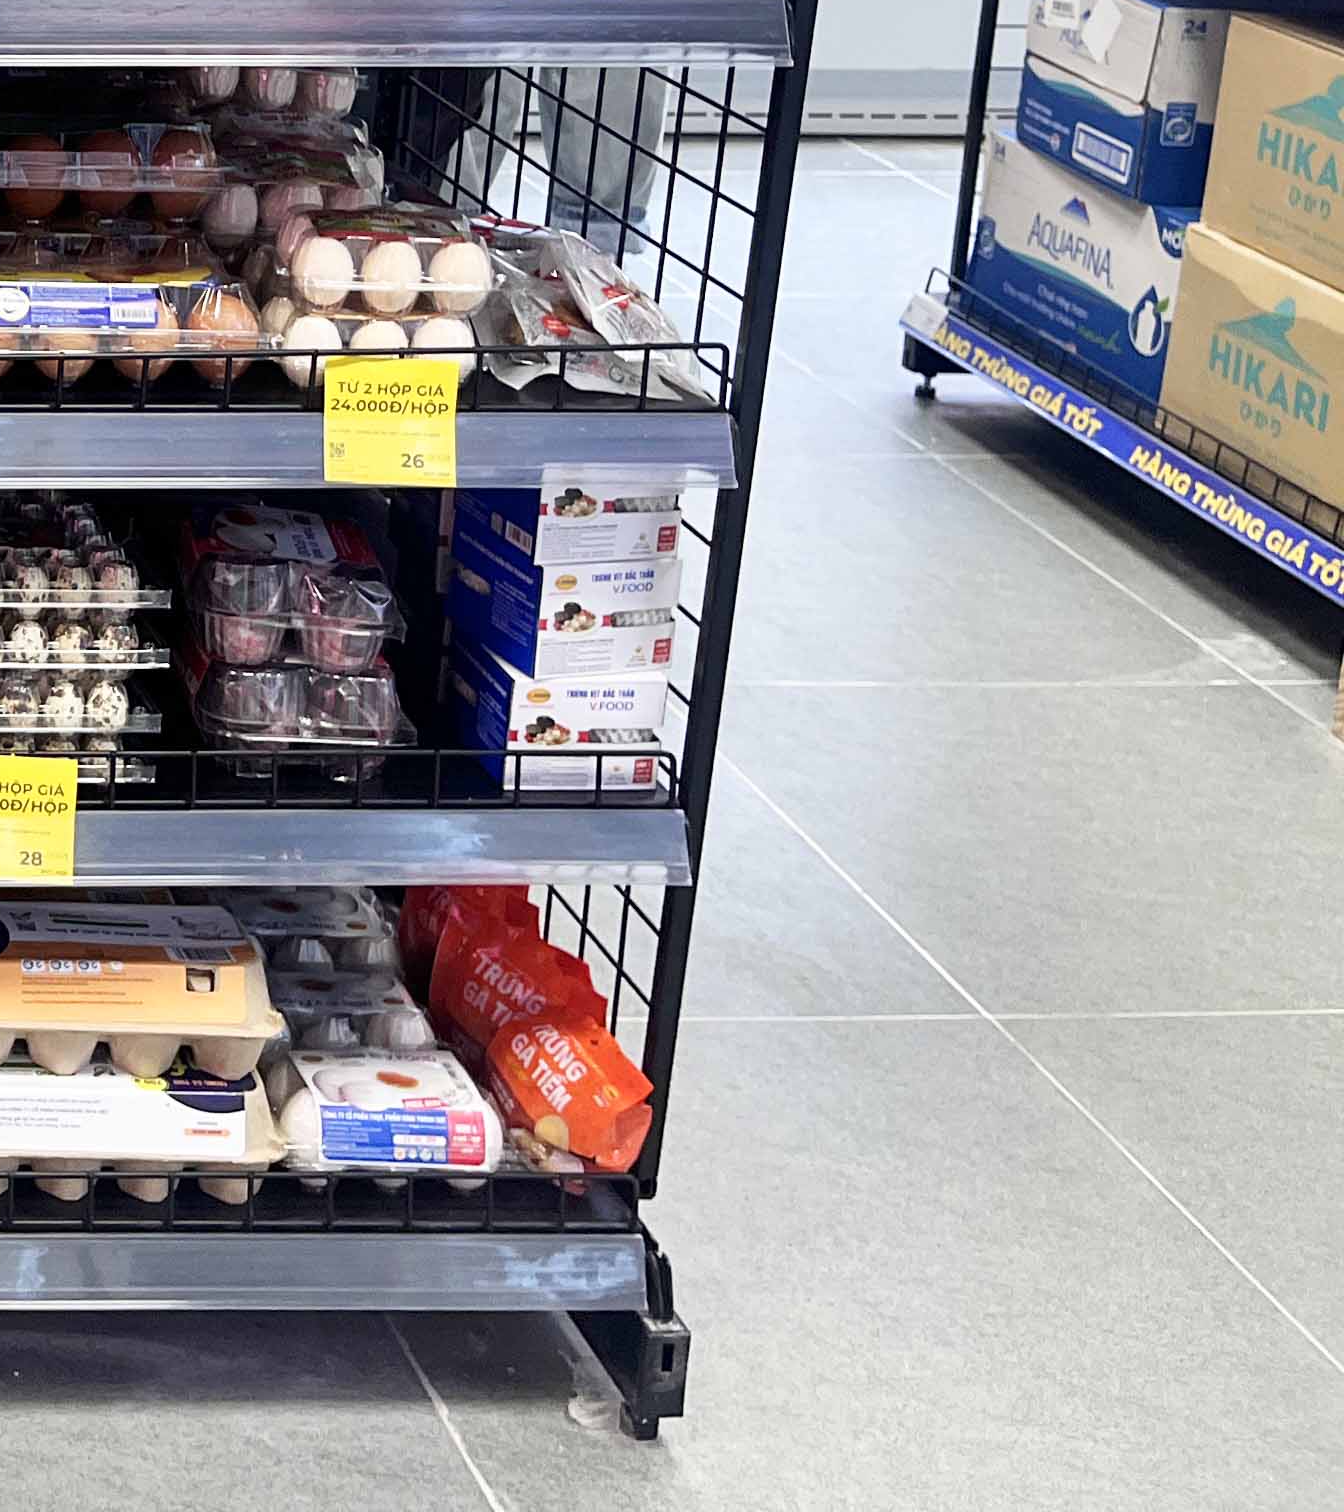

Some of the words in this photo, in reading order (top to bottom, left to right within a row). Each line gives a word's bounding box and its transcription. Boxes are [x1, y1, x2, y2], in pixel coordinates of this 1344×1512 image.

[1026, 212, 1112, 283] AQUAFINA
[364, 384, 372, 394] 2
[377, 382, 412, 398] HỘP
[416, 384, 444, 397] GIÁ
[971, 346, 1031, 394] THÙNG
[1029, 383, 1063, 419] GIÁ
[1063, 401, 1104, 439] TỐT
[1208, 333, 1331, 432] HIKARI
[330, 398, 449, 418] 24.000Đ/HỘP
[400, 453, 424, 468] 26
[1129, 446, 1191, 497] HÀNG
[1191, 485, 1264, 544] THÙNG
[1265, 529, 1308, 570] GIÁ
[20, 851, 42, 866] 28
